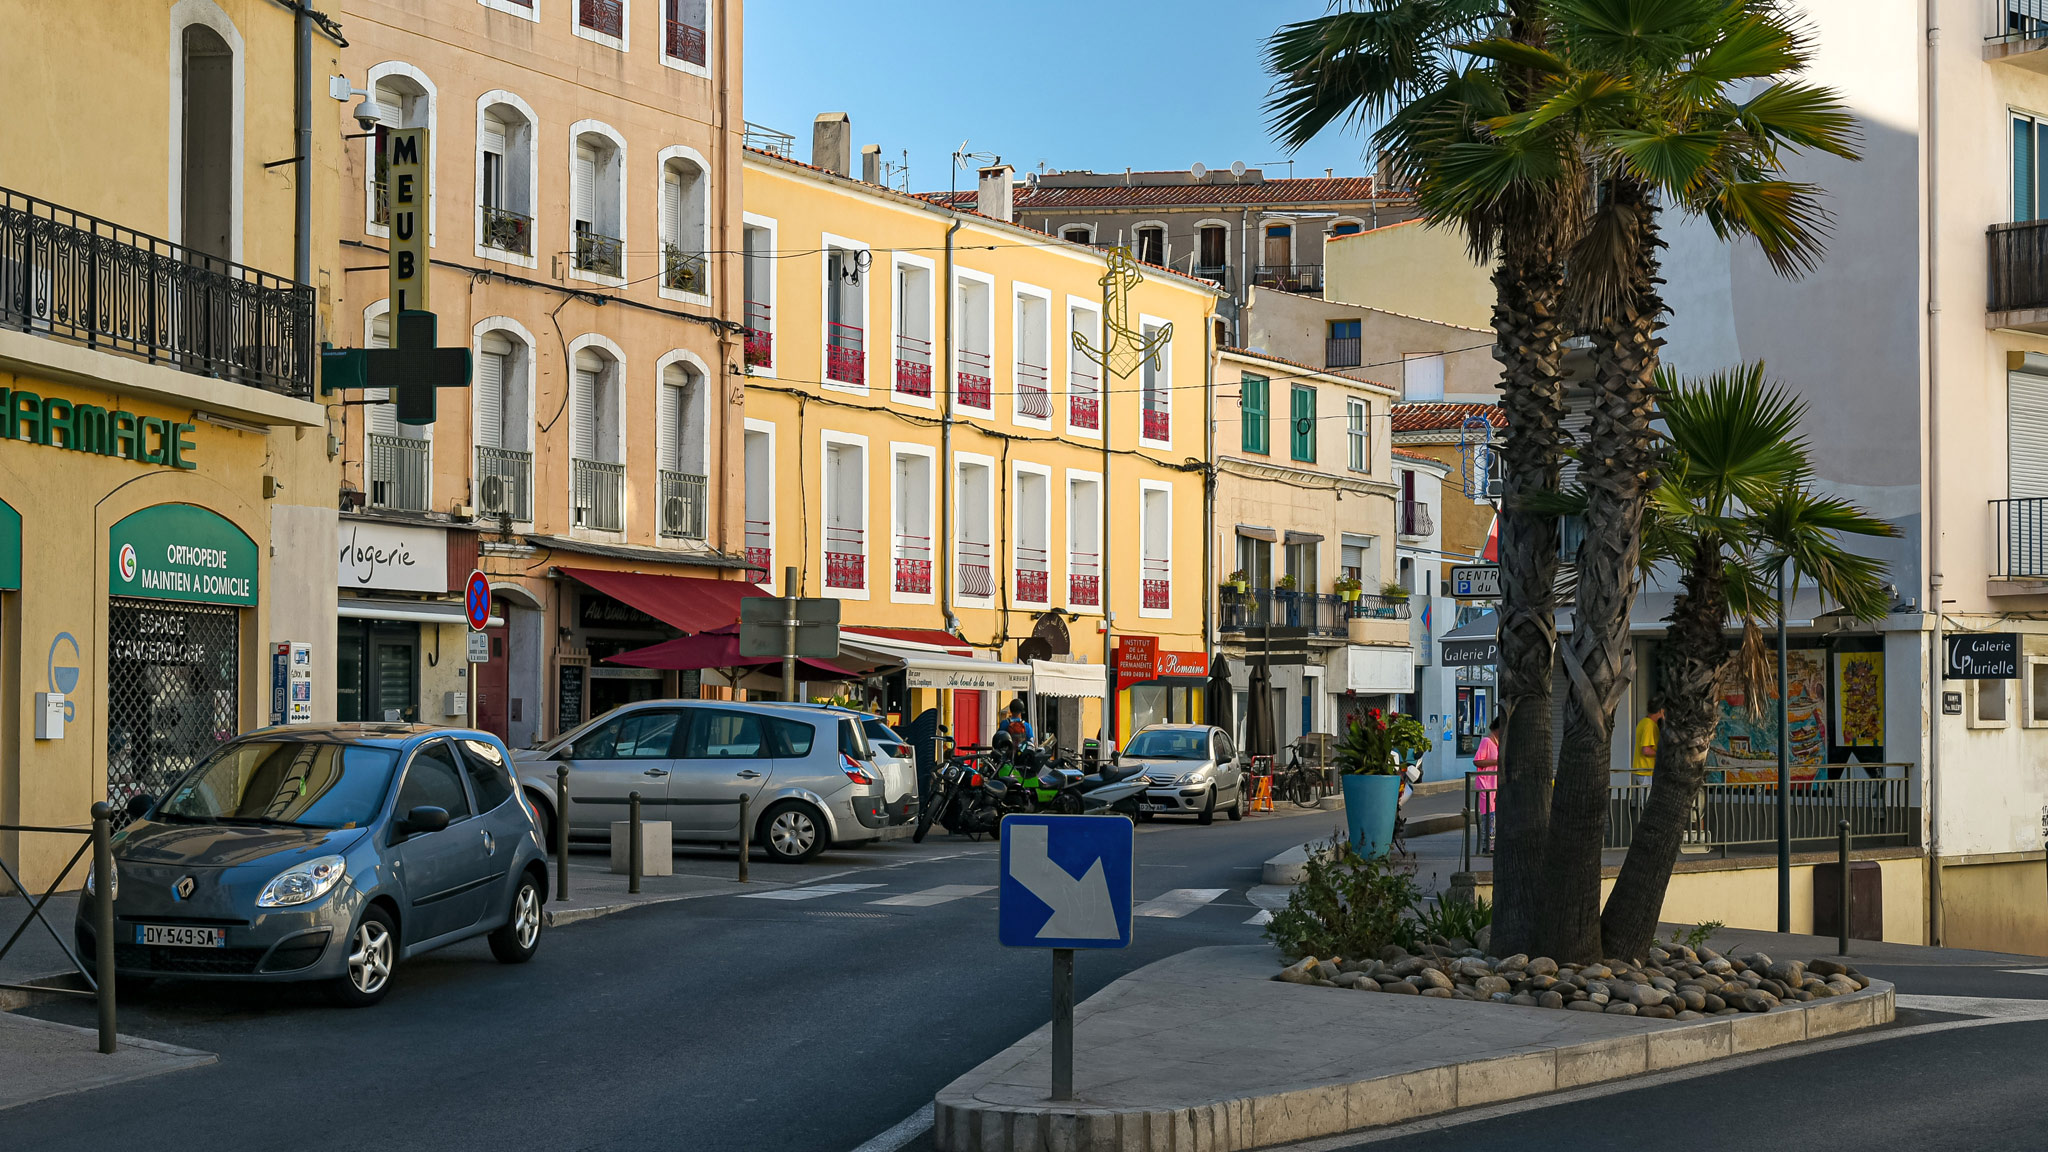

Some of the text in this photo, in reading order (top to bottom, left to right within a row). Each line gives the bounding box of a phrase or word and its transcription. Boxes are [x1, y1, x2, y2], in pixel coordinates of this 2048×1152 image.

[167, 544, 227, 569] ORTHOPEDIE
[340, 526, 416, 583] rlogerie
[142, 569, 250, 597] MAINTIEN A DOMICILE
[1477, 583, 1491, 592] du
[1124, 639, 1151, 647] INSTITUT
[1972, 640, 2011, 652] Galerie
[1444, 645, 1498, 661] Galerie P
[1165, 654, 1205, 674] Romaine
[1961, 655, 2014, 675] Plurielle
[960, 674, 973, 686] bout
